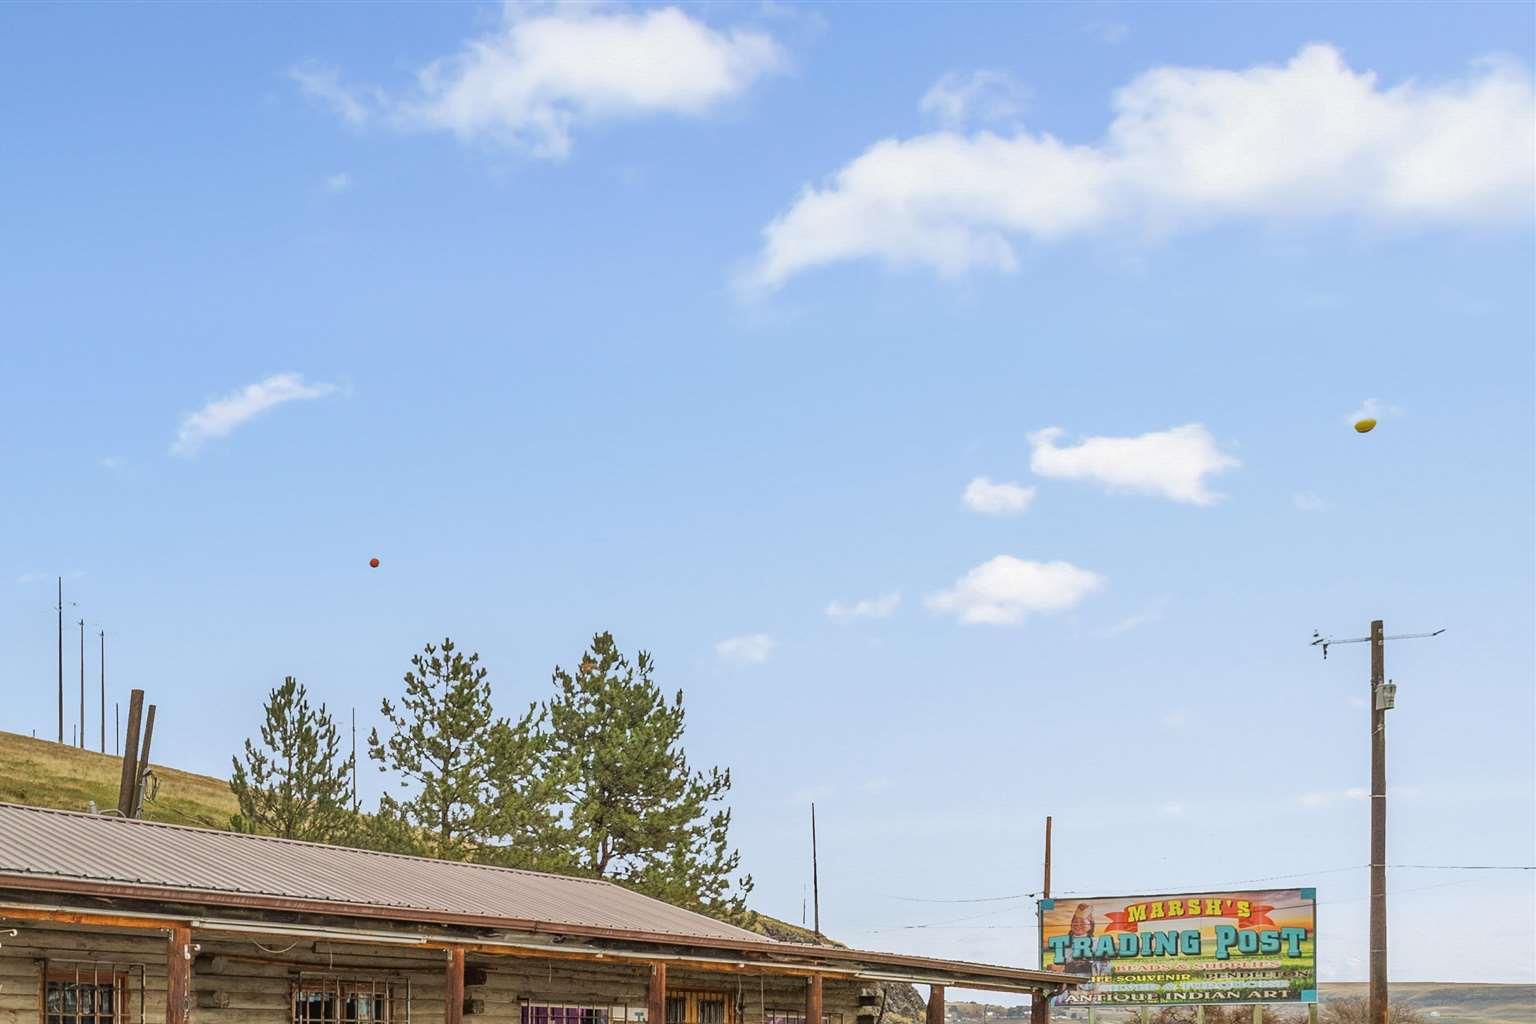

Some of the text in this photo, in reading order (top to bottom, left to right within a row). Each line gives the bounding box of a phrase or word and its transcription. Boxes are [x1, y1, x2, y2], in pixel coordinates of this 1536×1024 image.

[1128, 898, 1251, 922] MARSH'S
[1048, 925, 1307, 964] TRADING POST
[1115, 963, 1169, 973] BEADS
[1193, 960, 1281, 970] SUPPLIES
[1116, 972, 1192, 982] SOUVENIR
[1205, 969, 1311, 979] PENDLETON
[1065, 989, 1290, 1002] ANTIQUE INDIAN ART
